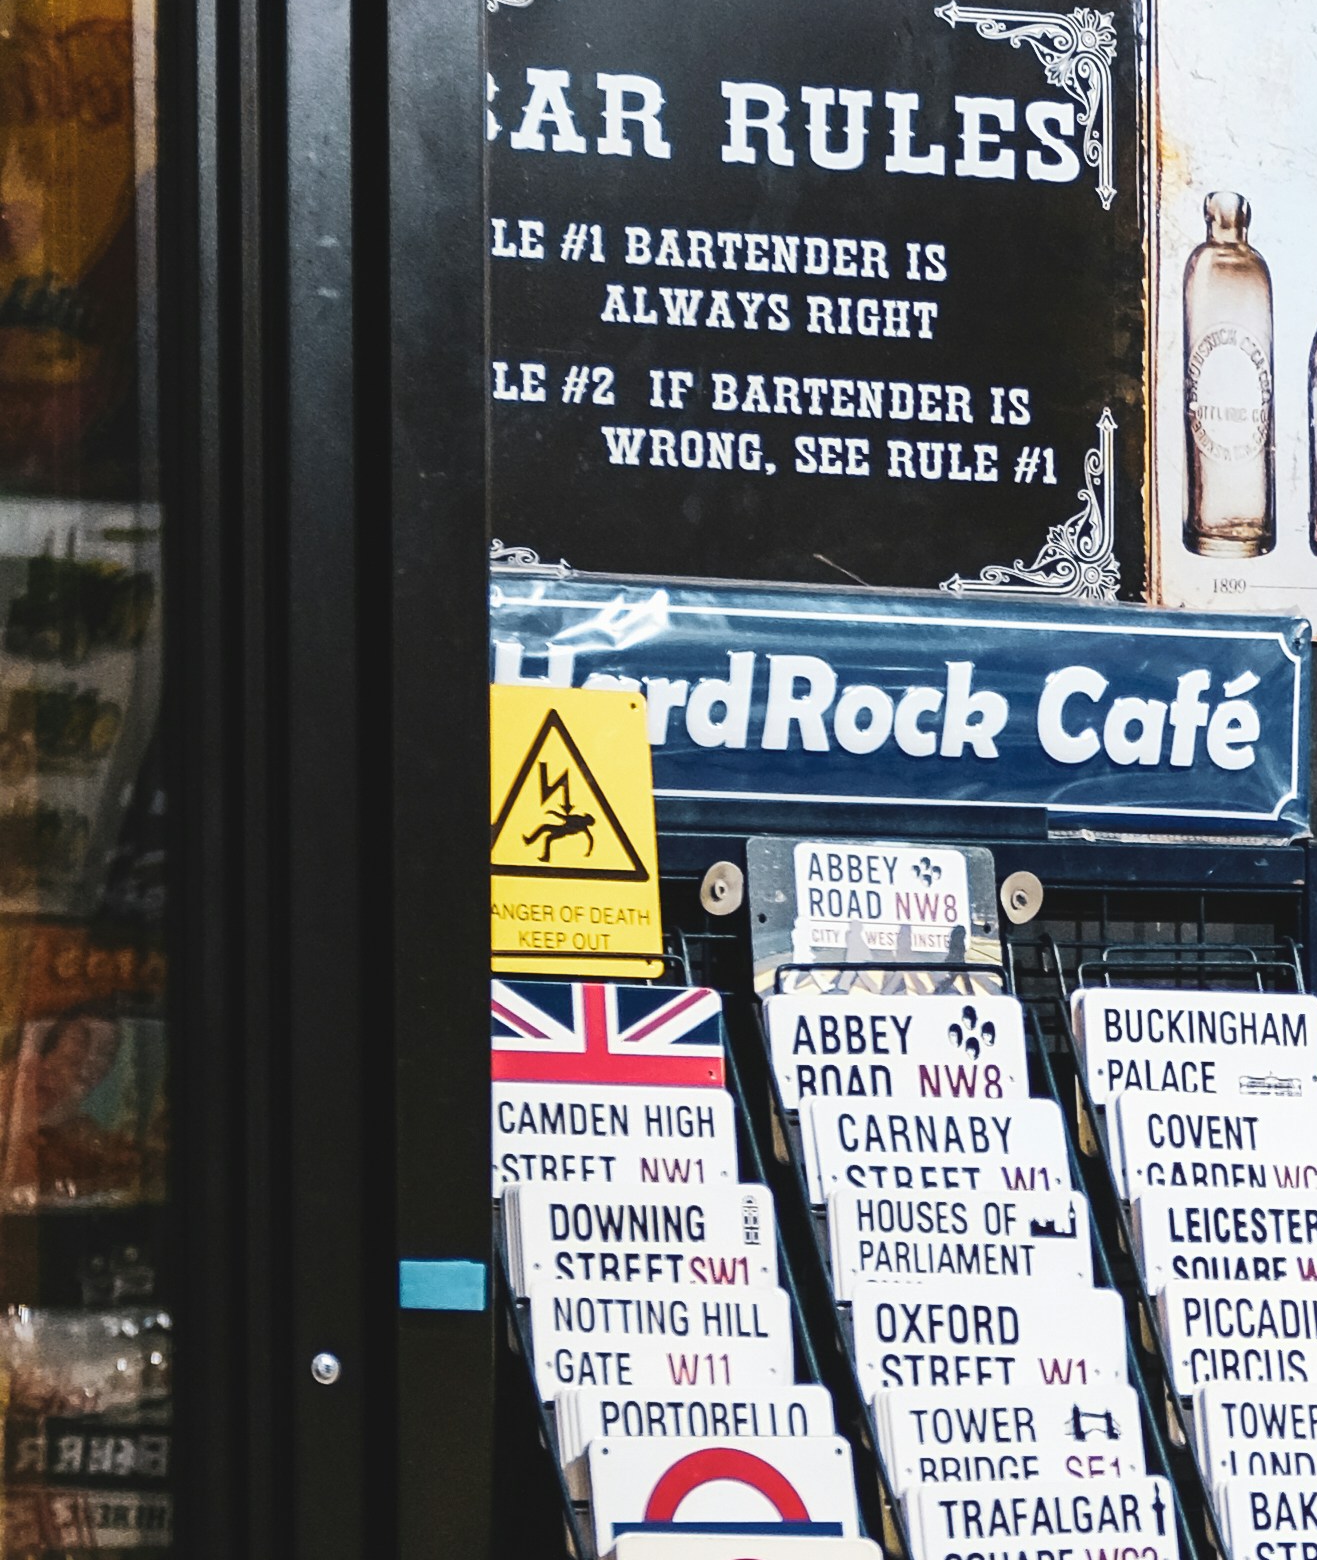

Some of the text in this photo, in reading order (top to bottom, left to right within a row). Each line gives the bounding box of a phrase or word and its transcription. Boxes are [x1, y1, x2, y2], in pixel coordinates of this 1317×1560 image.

[721, 79, 1083, 184] RULES
[559, 223, 947, 282] #1 BARTENDER IS
[600, 284, 938, 340] ALWAYS RIGHT
[561, 366, 1030, 426] #2 IF BARTENDER IS
[601, 426, 1057, 484] WRONG, SEE RULE #1
[1212, 578, 1246, 593] 1899
[1037, 665, 1262, 771] Café
[808, 852, 898, 885] ABBEY
[561, 905, 650, 925] OF DEATH
[809, 888, 959, 924] ROAD NW8
[518, 930, 610, 951] KEEP OUT
[1104, 1009, 1308, 1047] BUCKINGHAM
[1107, 1060, 1215, 1093] PALACE
[499, 1101, 715, 1138] CAMDEN HIGH
[838, 1113, 1012, 1155] CARNABY
[1148, 1113, 1258, 1150] COVENT
[549, 1203, 705, 1243] DOWNING
[857, 1199, 1017, 1236] HOUSES OF
[859, 1240, 1035, 1276] PARLIAMENT
[553, 1297, 768, 1338] NOTTING HILL
[876, 1304, 1020, 1344] OXFORD
[555, 1349, 731, 1385] GATE W11
[910, 1407, 1037, 1444] TOWER
[938, 1494, 1141, 1539] TRAFALGAR
